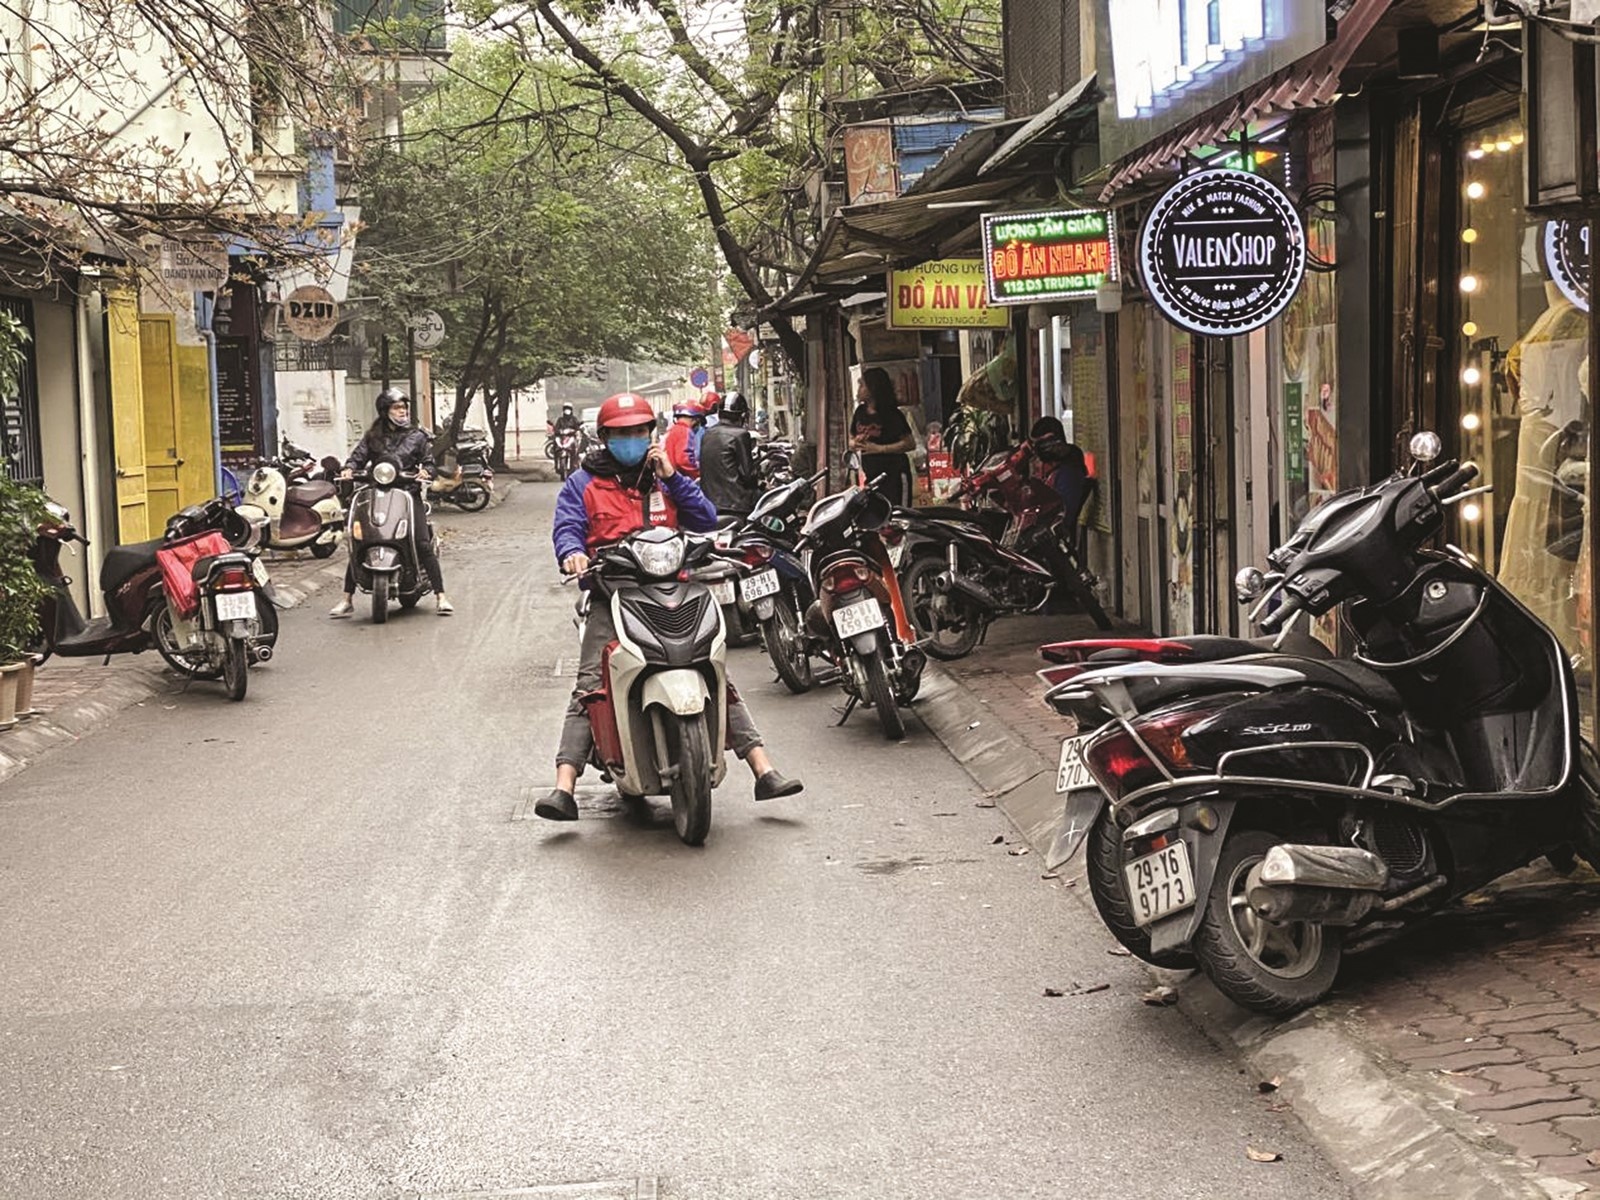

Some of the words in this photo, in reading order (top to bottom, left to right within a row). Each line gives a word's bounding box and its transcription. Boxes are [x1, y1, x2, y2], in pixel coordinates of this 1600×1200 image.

[1181, 202, 1197, 218] MIX
[1196, 198, 1205, 207] &
[1206, 191, 1233, 203] MATCH
[1234, 193, 1267, 215] FASHION
[961, 261, 985, 274] UYÊ
[994, 239, 1019, 278] ĐỒ
[1022, 243, 1047, 276] ĂN
[898, 276, 925, 310] ĐỒ
[932, 279, 959, 310] ĂN
[966, 280, 988, 316] VẶ
[1003, 280, 1025, 294] 112
[1043, 275, 1084, 290] TRUNG
[1133, 848, 1180, 890] 29-Y6
[1139, 877, 1186, 918] 9773
